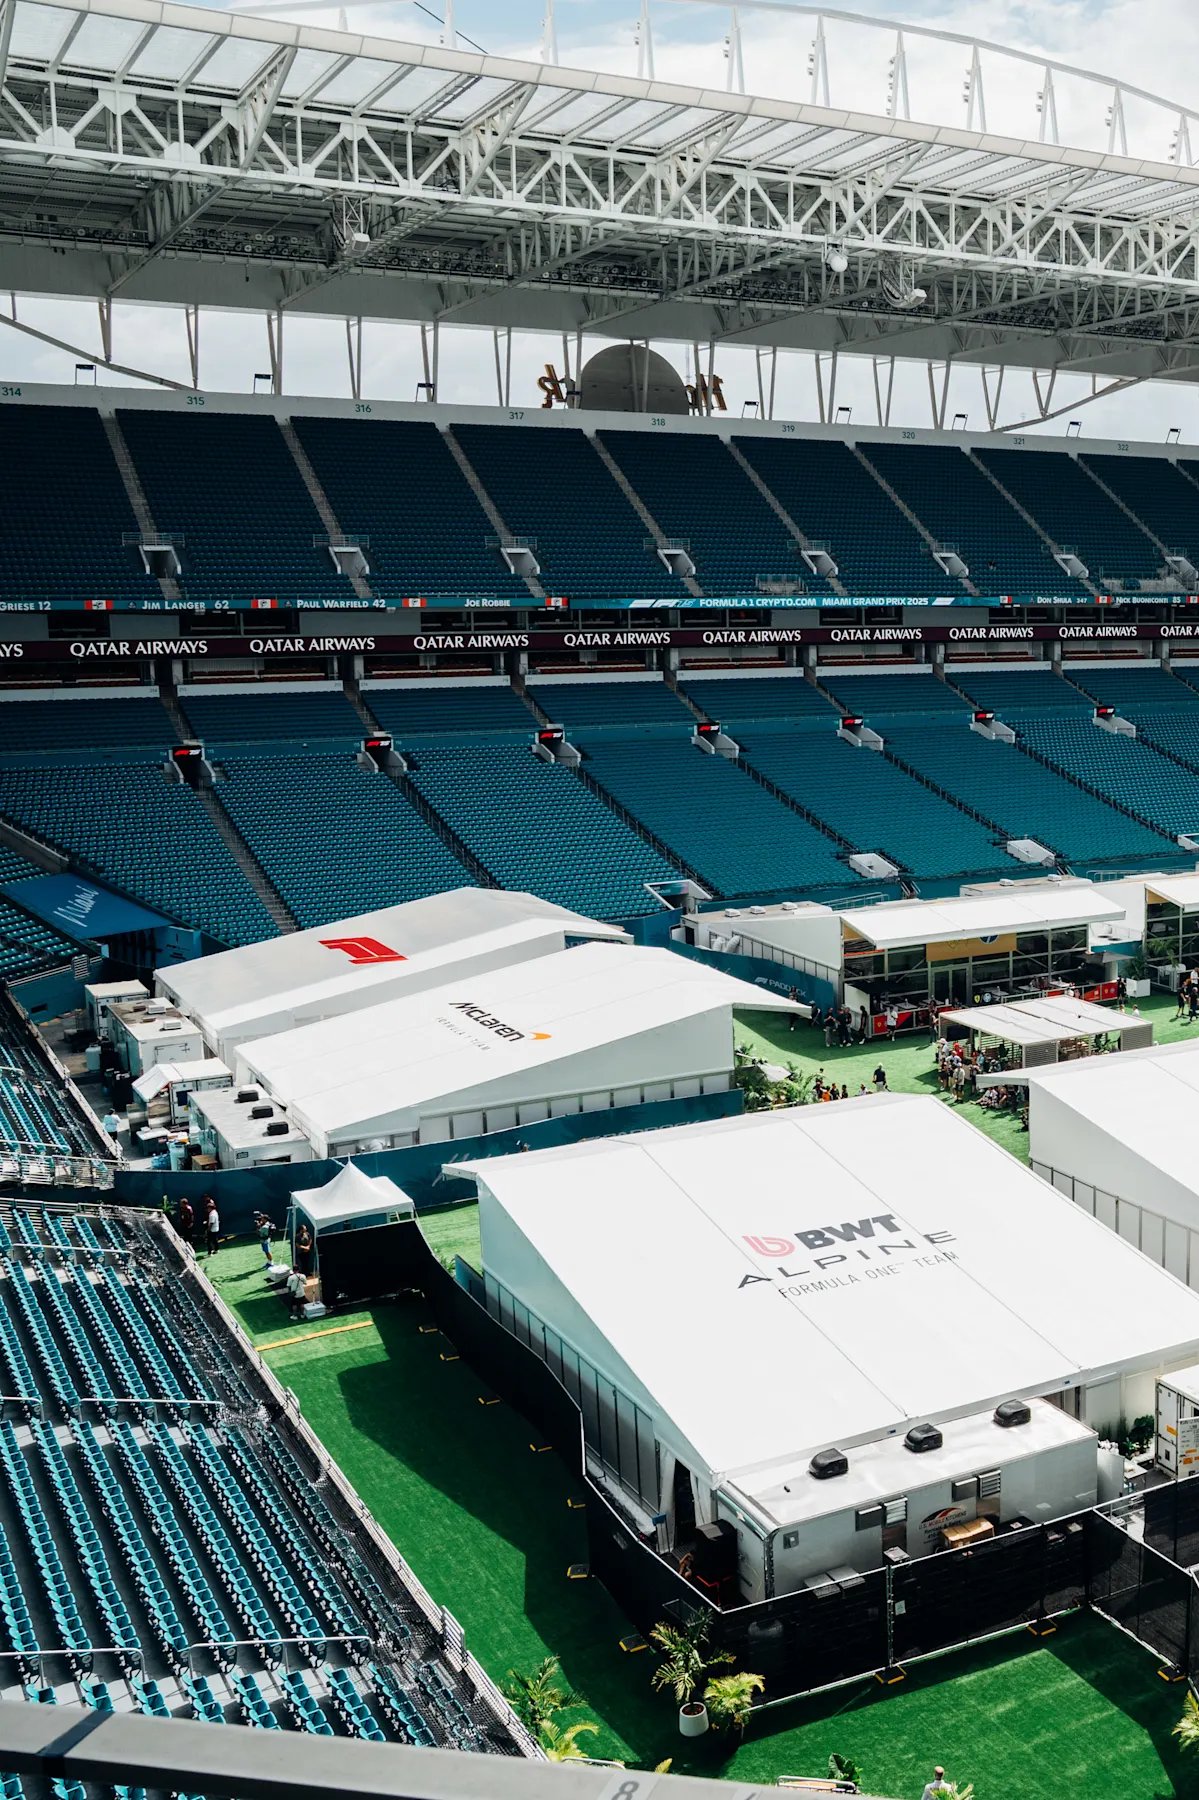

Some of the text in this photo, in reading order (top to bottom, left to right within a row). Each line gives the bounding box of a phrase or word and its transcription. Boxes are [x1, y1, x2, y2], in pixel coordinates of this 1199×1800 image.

[1, 387, 22, 397] 314
[186, 396, 205, 406] 315
[354, 403, 372, 413] 316
[509, 412, 524, 420] 317
[651, 418, 666, 426] 318
[781, 424, 795, 433] 319
[902, 431, 915, 439] 320
[1013, 437, 1025, 445] 321
[1117, 443, 1129, 451] 322
[0, 601, 51, 611] GRIESE 12
[142, 600, 230, 610] JIM LANGER 62
[296, 599, 386, 608] PAUL WARFIELD 42
[464, 598, 511, 607] JOE ROBBIE
[699, 599, 747, 607] FORMULA
[756, 598, 816, 607] CRYPTO.COM
[822, 598, 851, 606] MIAMI
[852, 597, 884, 606] GRAND
[885, 597, 906, 605] PRIX
[907, 597, 929, 605] 2025
[831, 629, 922, 642] QATAR AIRWAYS
[949, 627, 1034, 640] QATAR AIRWAYS
[1059, 626, 1137, 638] QATAR AIRWAYS
[1160, 626, 1192, 637] QATAR
[413, 634, 529, 650] QATAR AIRWAYS
[563, 631, 671, 647] QATAR AIRWAYS
[703, 630, 802, 645] QATAR AIRWAYS
[70, 640, 208, 657] QATAR AIRWAYS
[250, 637, 376, 654] QATAR AIRWAYS
[769, 979, 807, 998] PADDCK
[448, 1002, 526, 1042] McLaren
[794, 1213, 902, 1250] BWT
[737, 1230, 957, 1289] ALPINE
[778, 1274, 861, 1299] FORMULA
[912, 1250, 960, 1268] TEAM
